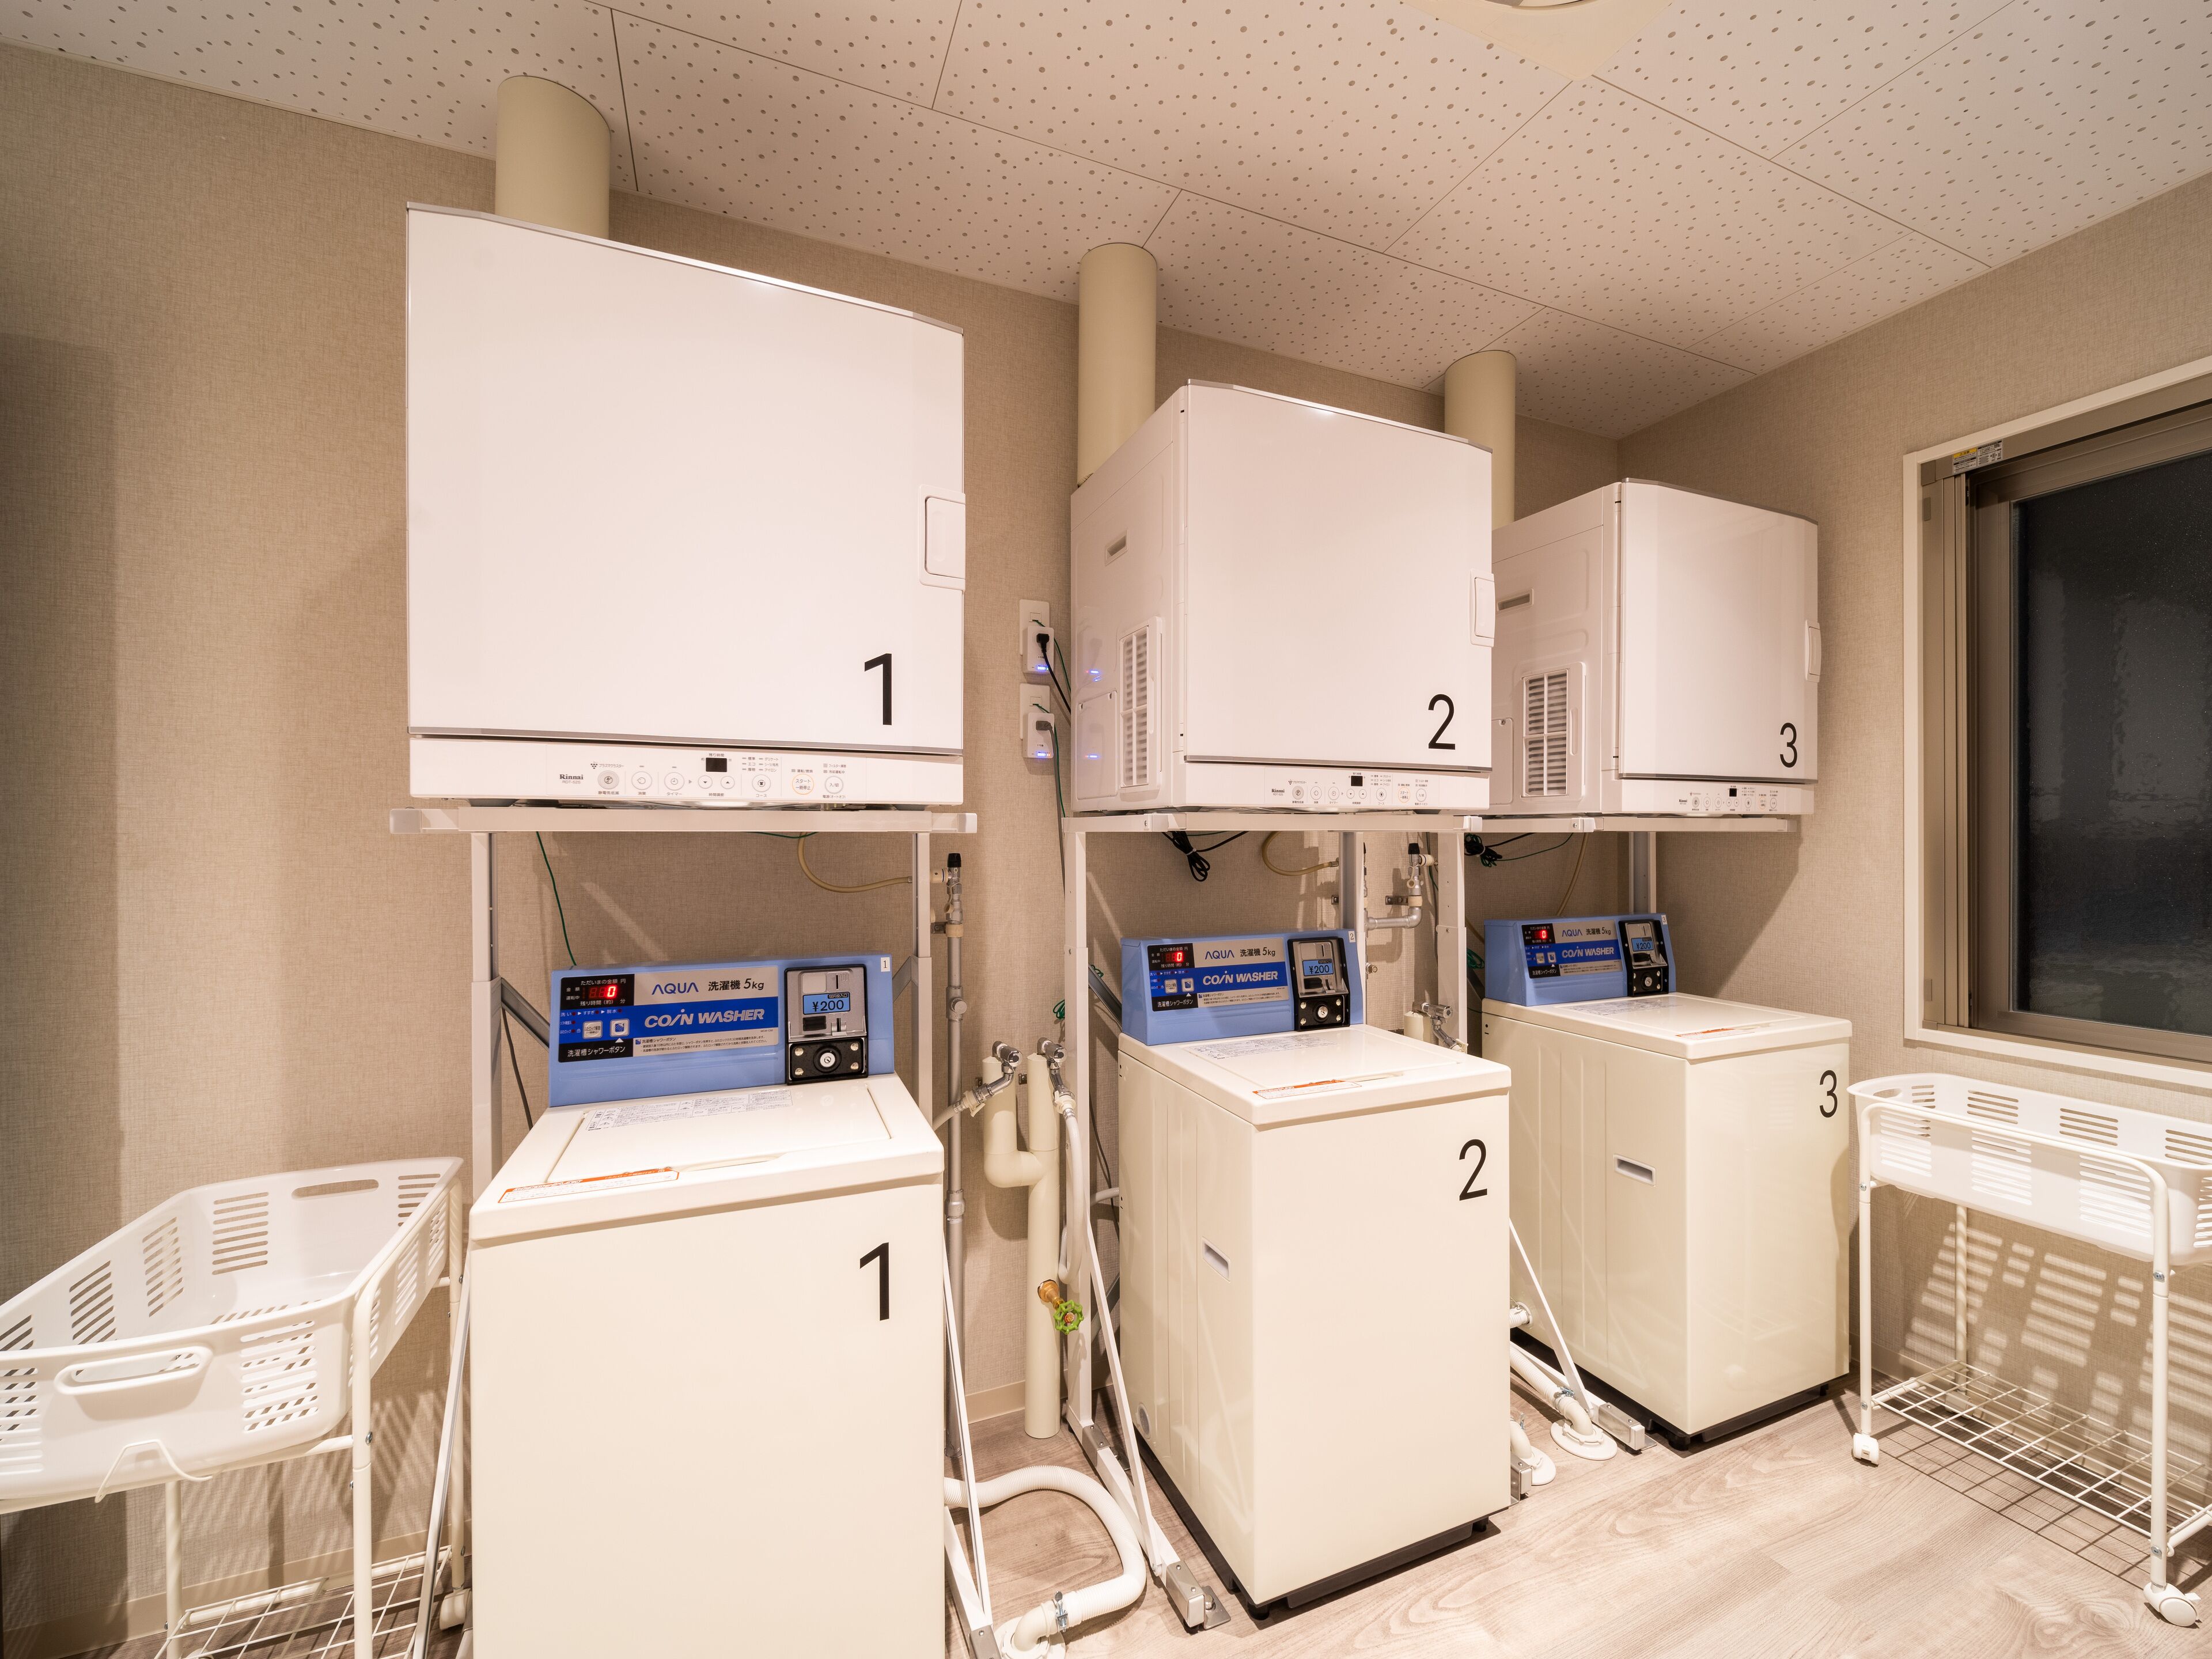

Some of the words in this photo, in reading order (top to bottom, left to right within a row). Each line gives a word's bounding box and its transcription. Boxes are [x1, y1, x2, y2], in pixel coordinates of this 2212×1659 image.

[864, 653, 892, 725] 1
[1428, 694, 1456, 750] 2
[1780, 722, 1797, 768] 3
[1542, 930, 1546, 938] 0
[1562, 929, 1582, 937] AQUA
[1601, 927, 1611, 935] 5kg
[1177, 952, 1182, 961] 0
[1205, 949, 1234, 960] AQUA
[1240, 948, 1260, 957] 洗濯機
[1262, 946, 1276, 957] 5kg
[1585, 947, 1614, 956] WASHER
[883, 960, 887, 968] 1
[1309, 965, 1330, 974] ¥200
[1236, 971, 1278, 983] WASHER
[607, 986, 616, 997] 0
[652, 982, 699, 995] AQUA
[708, 979, 740, 991] 洗濯機
[743, 978, 764, 990] 5kg
[812, 999, 844, 1012] ¥200
[1157, 999, 1193, 1007] 洗濯槽シャワーボタン
[698, 1009, 765, 1024] WASHER
[567, 1046, 626, 1057] 洗濯槽シャワーボタン
[1819, 1070, 1838, 1118] 3
[1459, 1139, 1487, 1201] 2
[859, 1242, 889, 1321] 1
